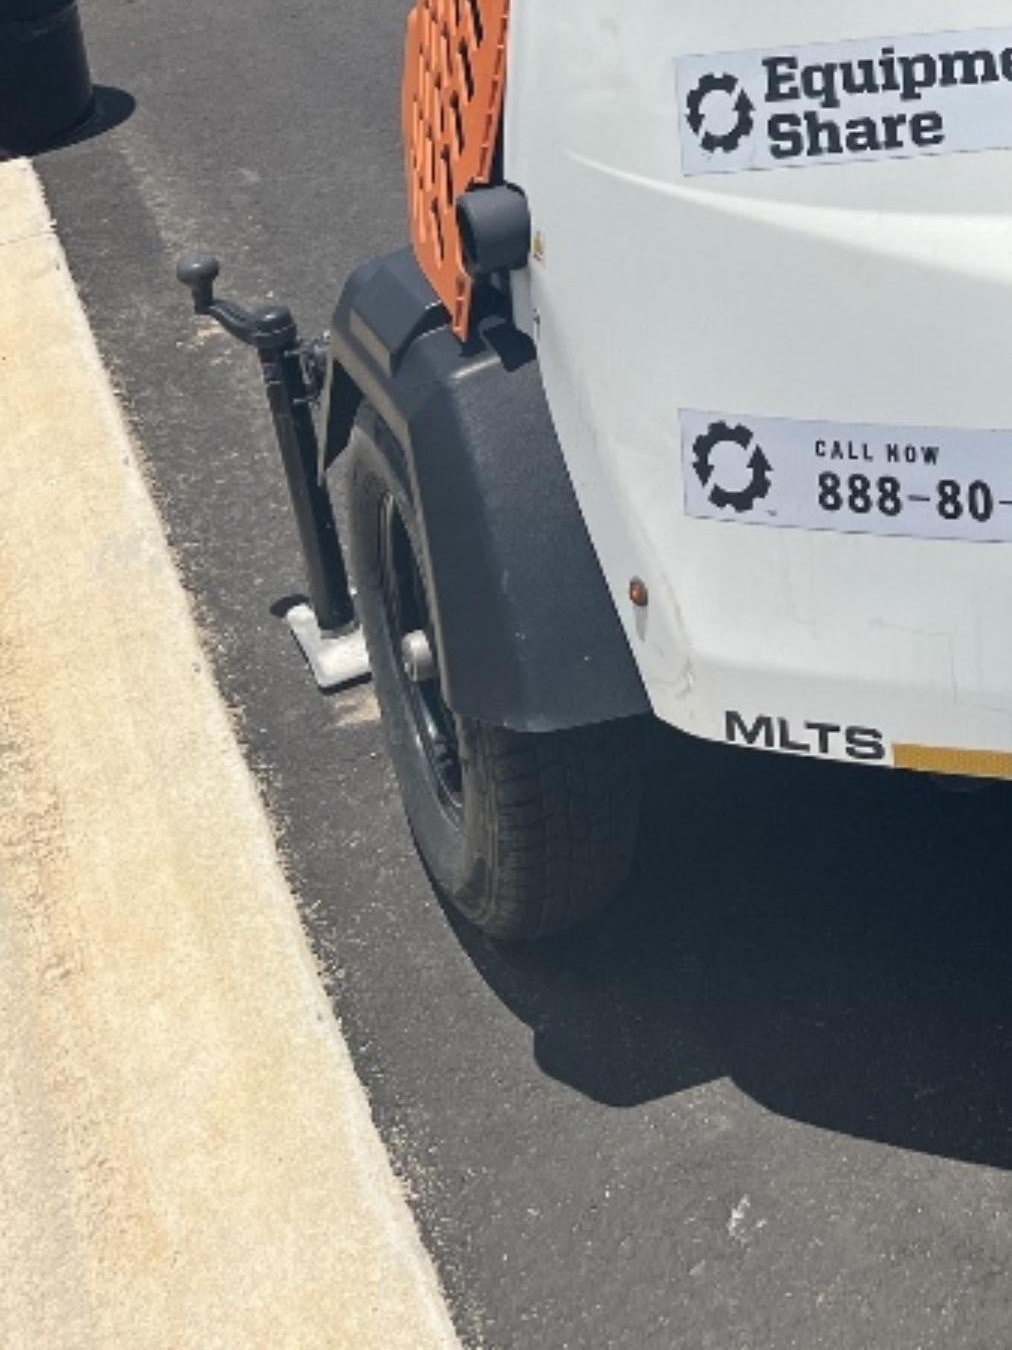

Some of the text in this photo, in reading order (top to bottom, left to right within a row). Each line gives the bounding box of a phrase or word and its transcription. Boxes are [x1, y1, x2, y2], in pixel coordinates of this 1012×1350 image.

[767, 110, 944, 159] Share
[815, 440, 939, 465] CALL NOW
[725, 710, 885, 759] MLTS
